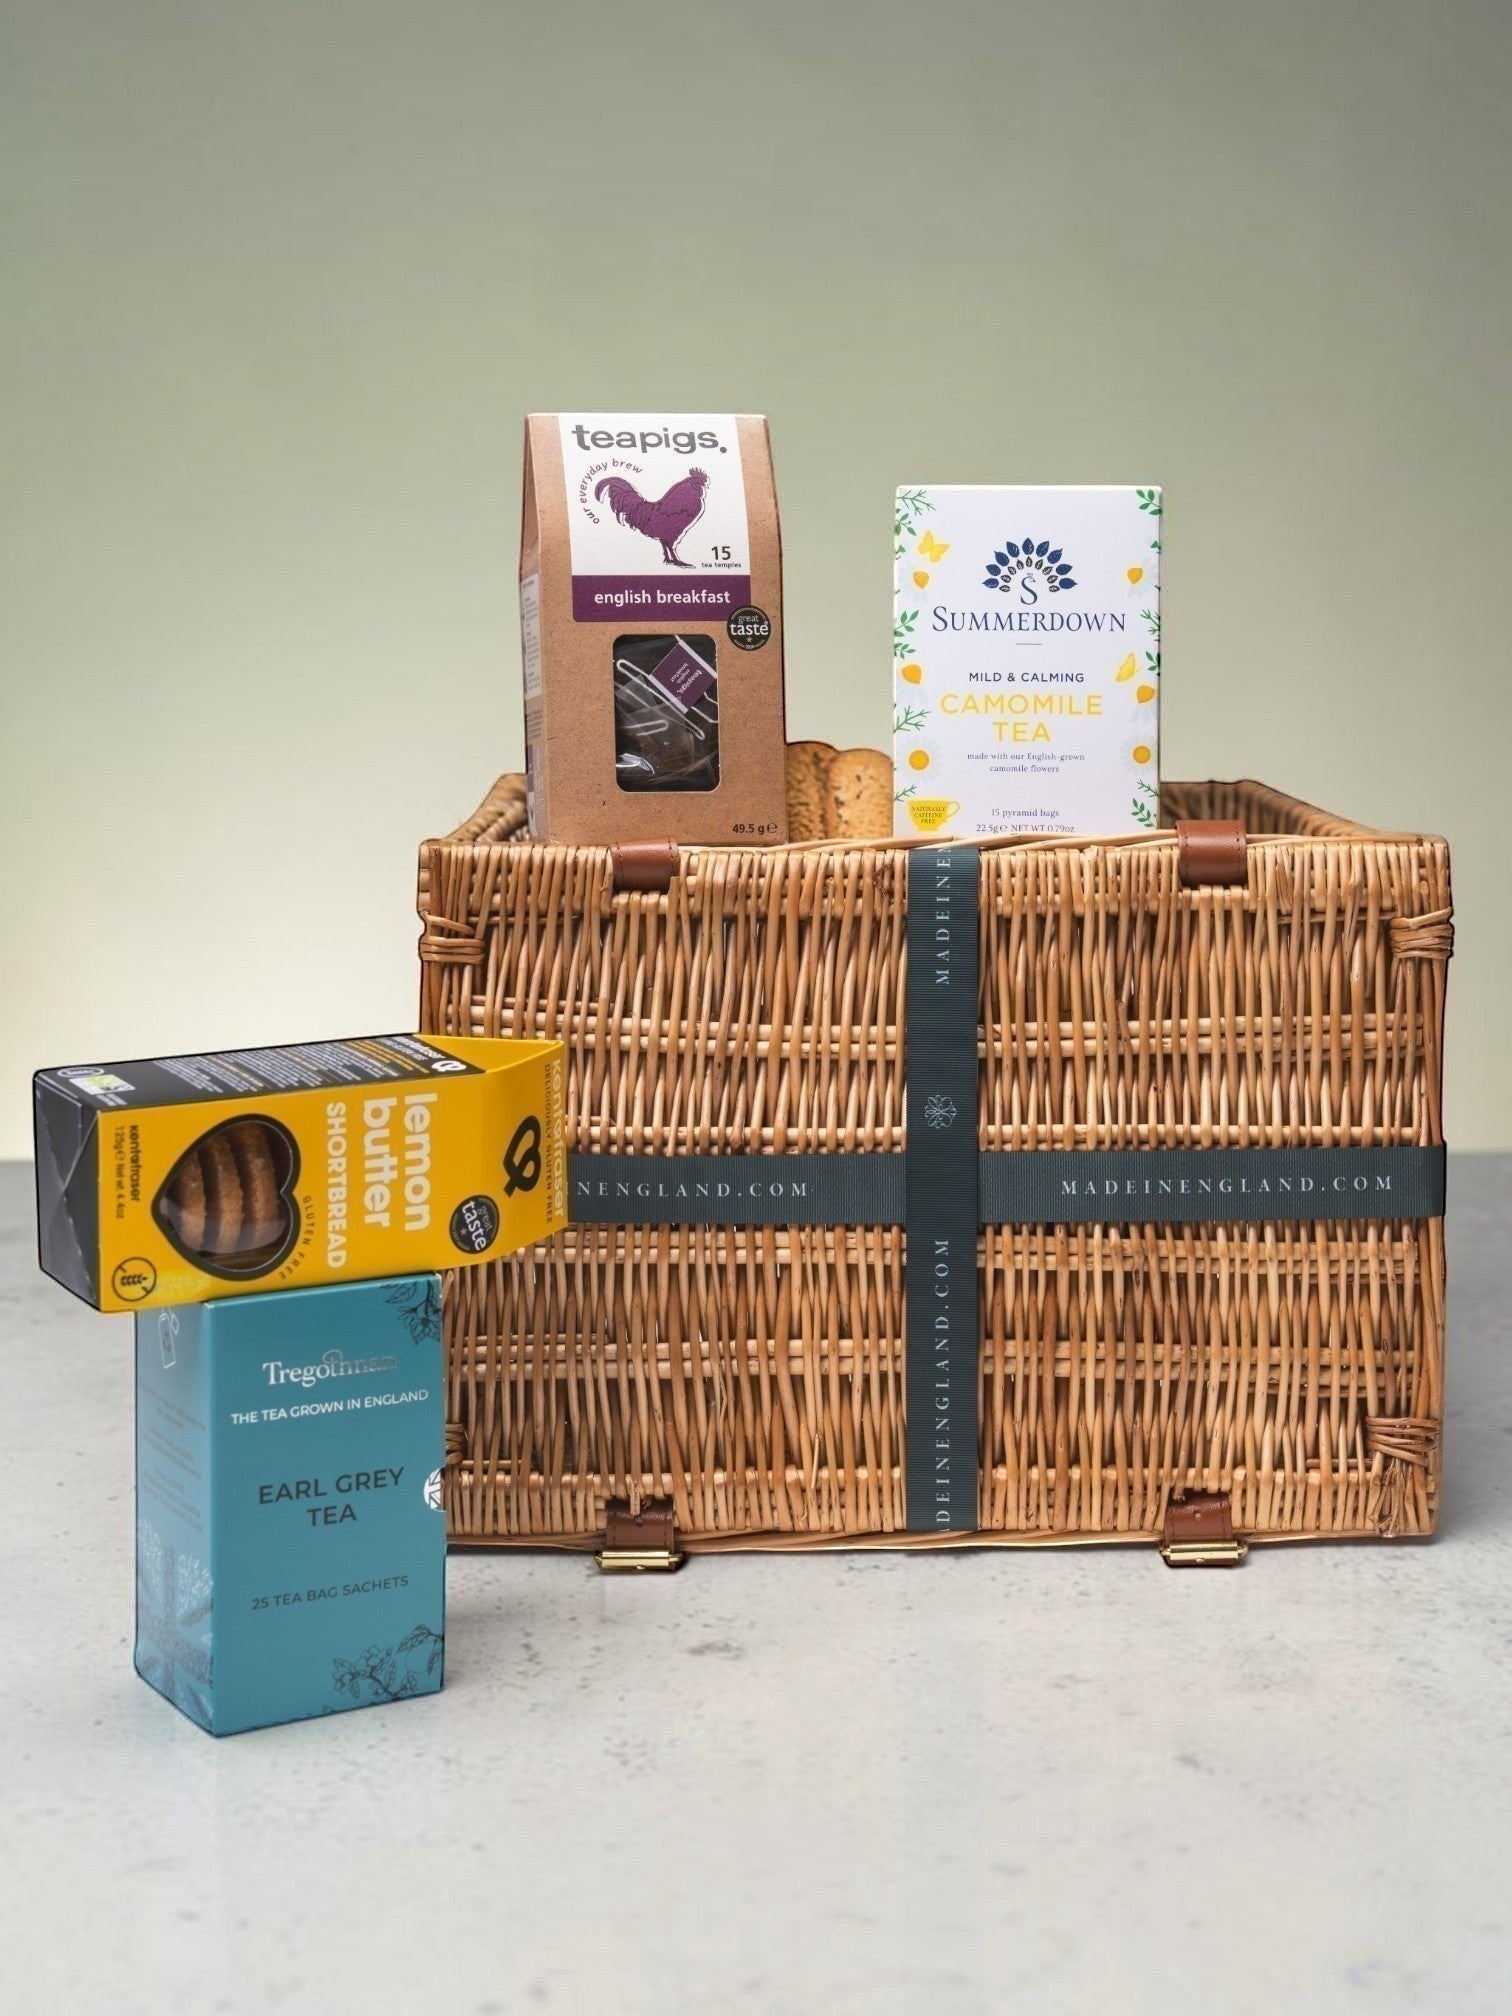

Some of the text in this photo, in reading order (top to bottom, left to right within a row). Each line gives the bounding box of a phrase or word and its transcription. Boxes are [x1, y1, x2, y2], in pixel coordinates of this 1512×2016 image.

[571, 424, 727, 454] teapigs.
[579, 458, 643, 524] our everyday brew
[711, 546, 731, 560] 15
[594, 589, 730, 607] english breakfast
[730, 623, 769, 635] taste
[738, 614, 759, 624] great
[932, 605, 1126, 632] SUMMERDOWN
[969, 672, 1085, 683] MILD & CALMING
[940, 693, 1103, 715] CAMOMILE
[992, 721, 1051, 742] TEA
[967, 752, 989, 760] made
[991, 752, 1008, 760] with
[1027, 752, 1085, 762] English-grown
[989, 764, 1060, 773] camomile flowers
[991, 808, 1060, 818] 15 pyramid bags
[732, 824, 755, 833] 49.5
[1011, 824, 1029, 832] NET
[1031, 824, 1046, 832] WT
[1047, 824, 1075, 833] 0.79oz
[544, 1063, 552, 1143] DELICIOUSLY
[363, 1096, 398, 1228] butter
[404, 1093, 438, 1231] lemon
[326, 1102, 347, 1268] SHORTBREAD
[1061, 1175, 1393, 1195] MADEINENGLAND.COM
[462, 1200, 487, 1251] taste
[477, 1205, 492, 1231] great
[280, 1195, 314, 1280] GLUTEN FREE
[935, 1240, 950, 1531] DEINENGLAND.COM
[231, 1389, 429, 1425] THE TEA GROWN IN ENGLAND
[258, 1466, 405, 1505] EARL GREY
[306, 1503, 358, 1528] TEA
[252, 1574, 409, 1611] 25 TEA BAG SACHETS
